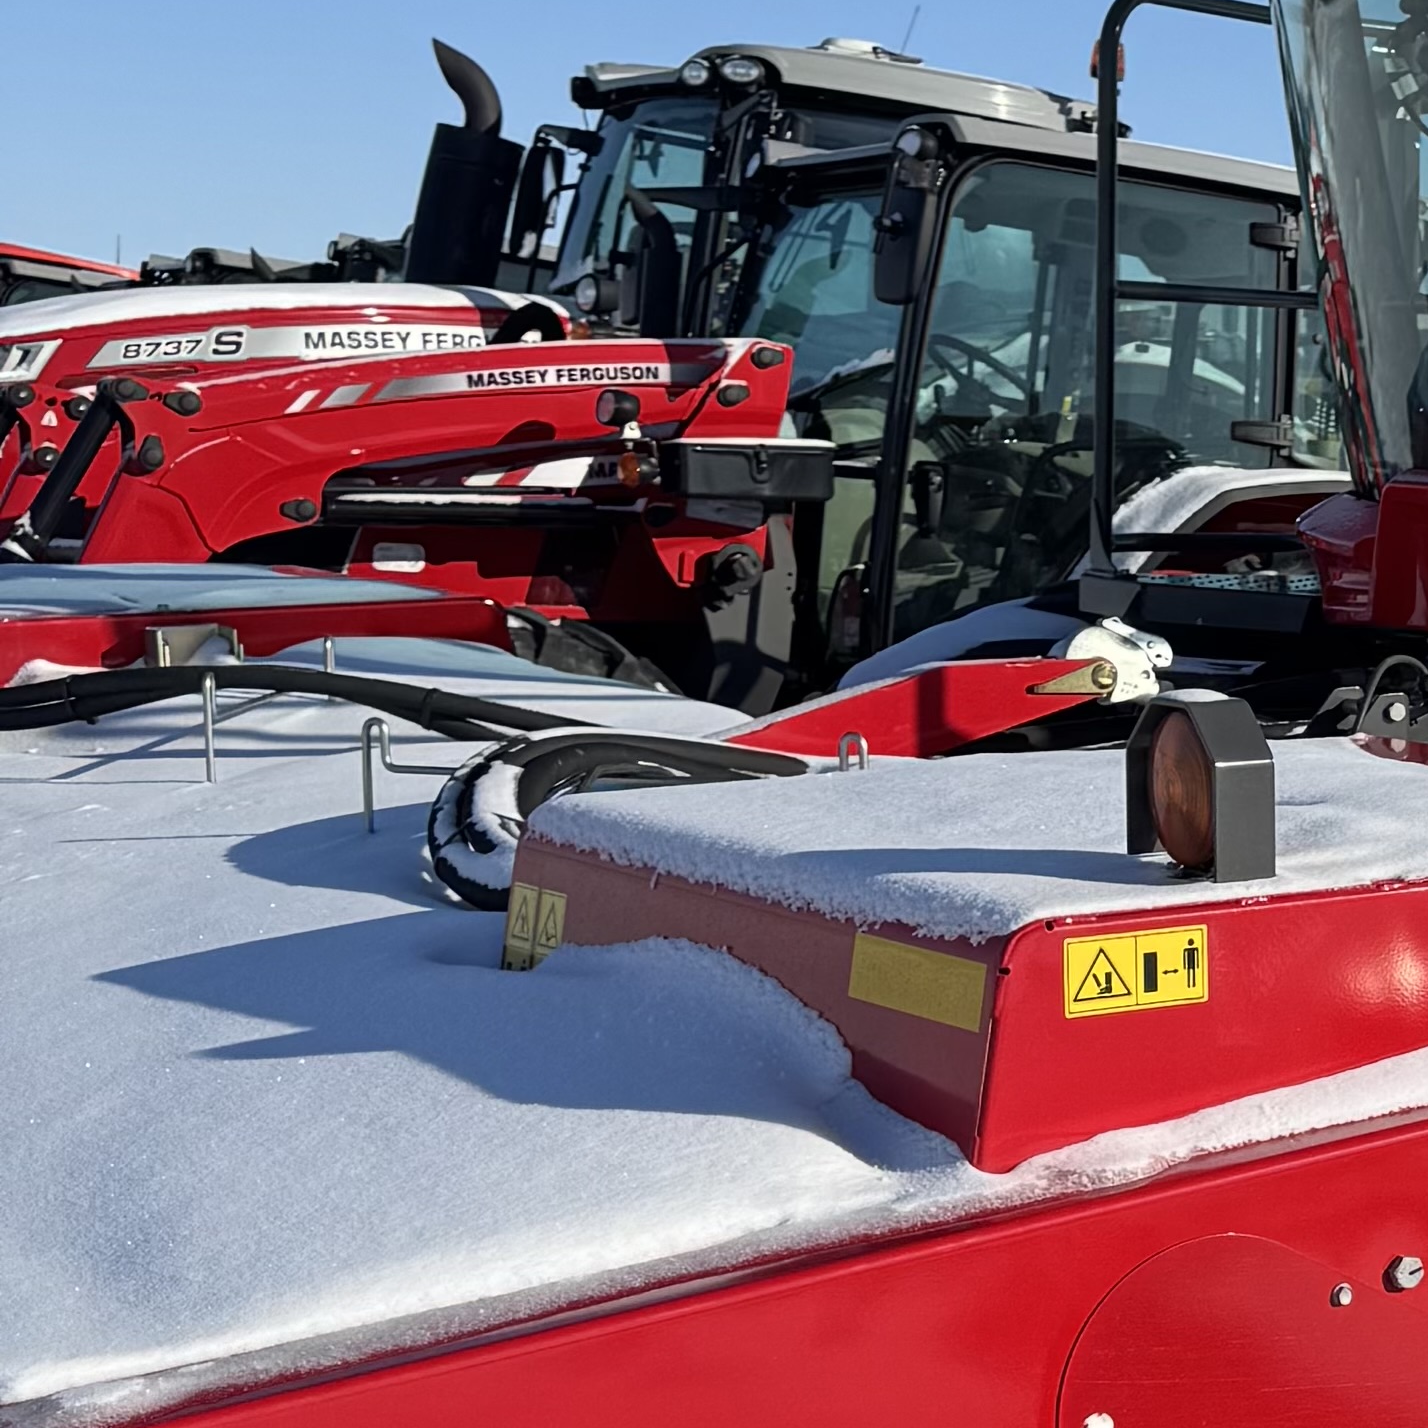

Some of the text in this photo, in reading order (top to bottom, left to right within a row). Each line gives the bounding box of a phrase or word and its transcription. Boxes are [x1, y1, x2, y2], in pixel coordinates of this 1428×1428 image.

[121, 338, 203, 360] 8737
[211, 330, 245, 356] S
[303, 330, 412, 351] MASSEY
[467, 366, 660, 389] MASSEY FERGUSON
